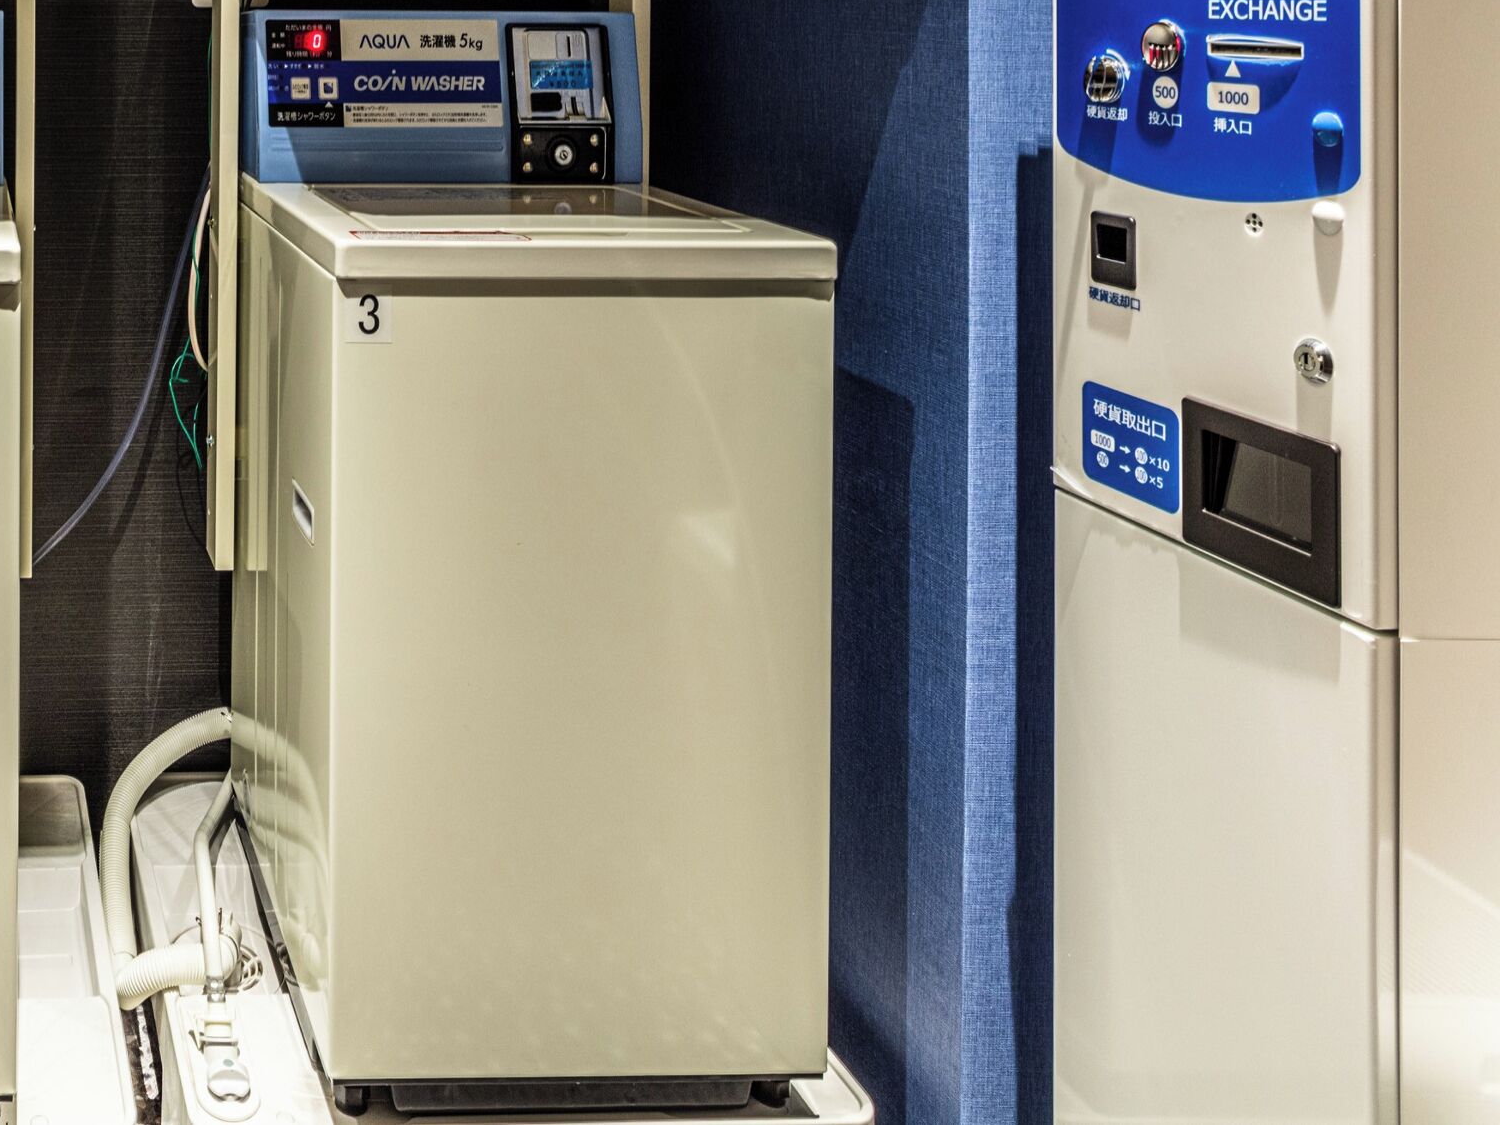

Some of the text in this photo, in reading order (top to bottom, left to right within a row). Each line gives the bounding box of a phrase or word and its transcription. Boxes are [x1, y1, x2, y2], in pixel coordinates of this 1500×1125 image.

[1208, 0, 1327, 21] EXCHANGE
[313, 34, 321, 48] 0
[359, 34, 410, 49] AQUA
[420, 33, 483, 51] 洗濯機 5kg
[411, 76, 484, 92] WASHER
[1155, 86, 1175, 99] 500
[1218, 91, 1248, 105] 1000
[1086, 105, 1127, 120] 硬貨返却
[1148, 112, 1182, 127] 投入口
[1213, 117, 1252, 135] 挿入口
[1089, 286, 1140, 312] 硬貨返却口
[359, 294, 380, 335] 3
[1093, 399, 1166, 441] 硬貨取出口
[1095, 433, 1111, 448] 1000
